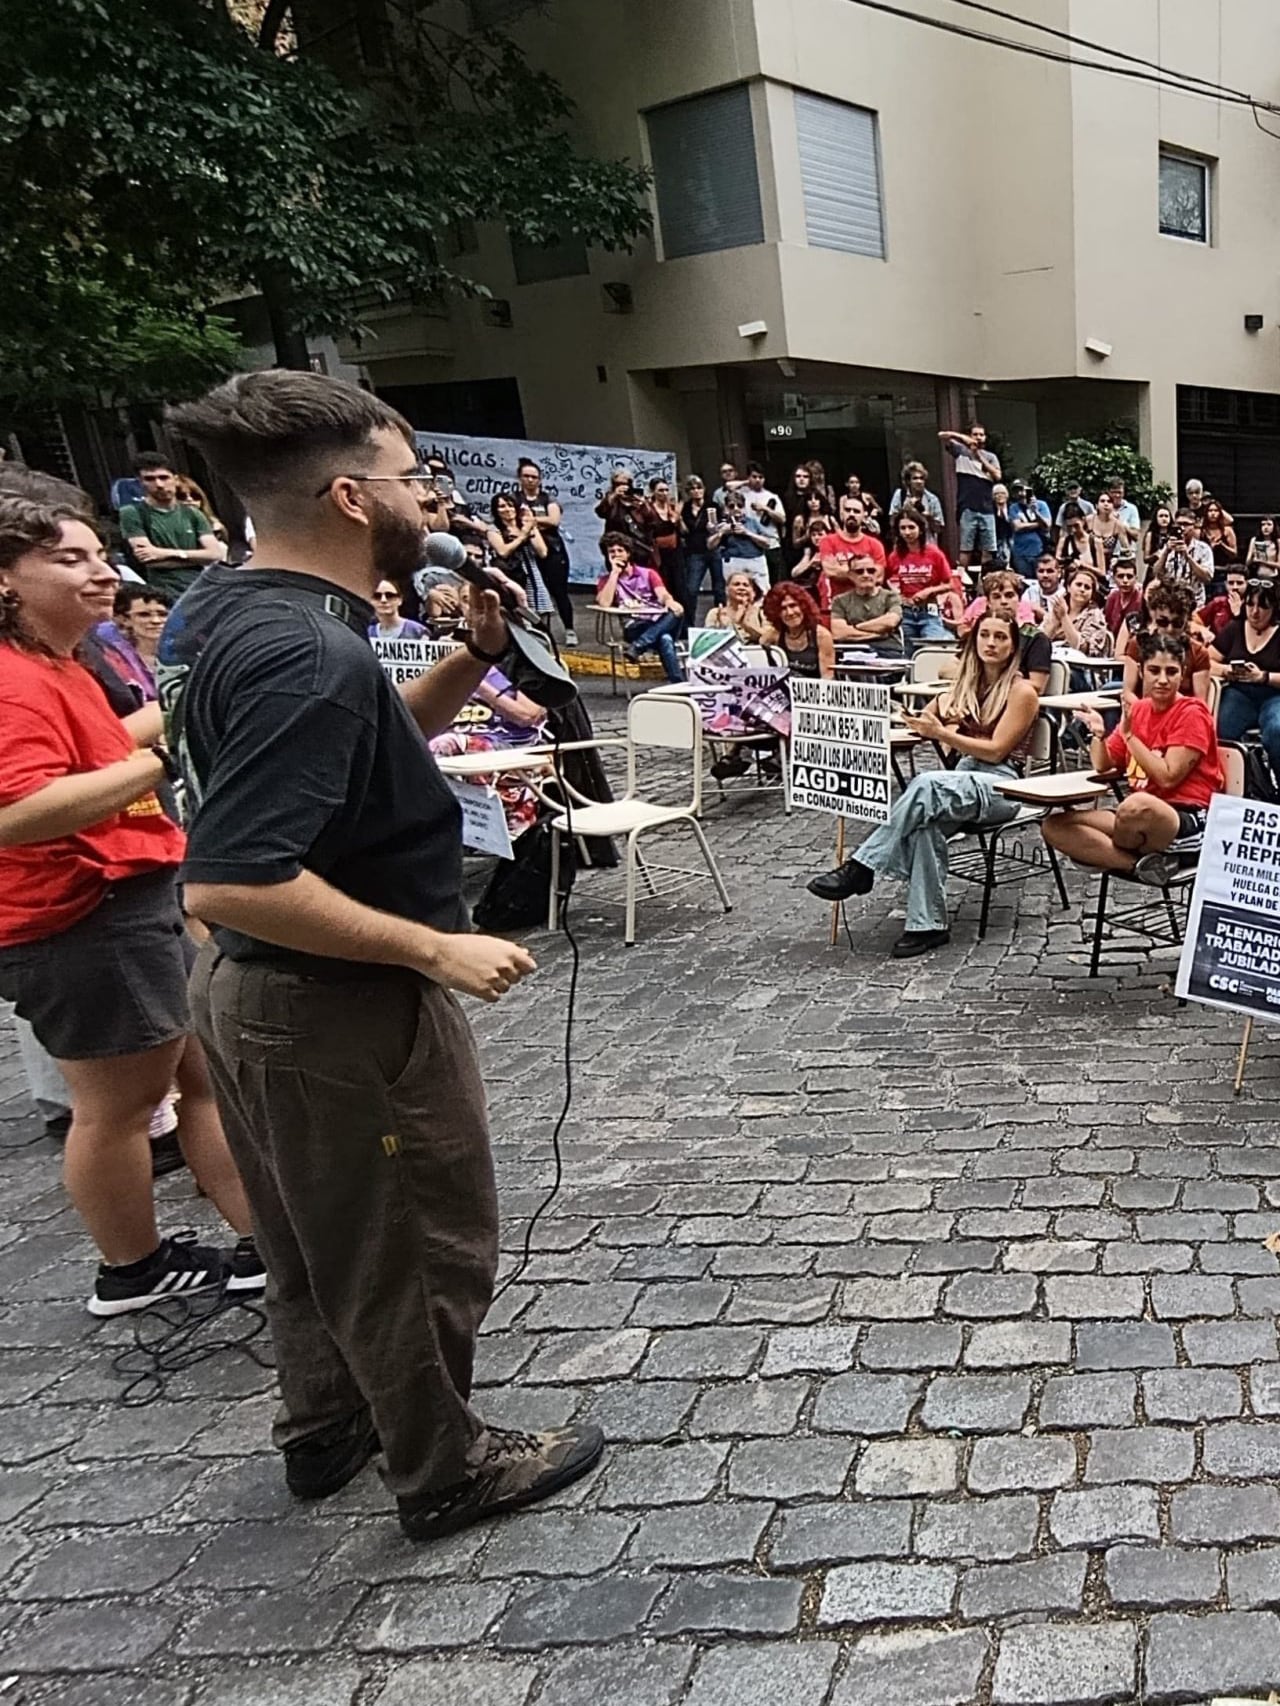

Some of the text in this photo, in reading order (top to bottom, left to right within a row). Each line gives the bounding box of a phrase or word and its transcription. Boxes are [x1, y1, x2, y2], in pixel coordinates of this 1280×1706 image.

[595, 488, 604, 500] s
[375, 641, 423, 661] CANASTA
[792, 682, 820, 705] SALARIO
[857, 687, 888, 712] FAMILIAR
[838, 717, 860, 740] 85%
[793, 740, 822, 765] SALARIO
[792, 793, 804, 803] en
[806, 792, 844, 811] CONADU
[1221, 840, 1233, 856] Y
[1224, 862, 1254, 878] FUERA
[1232, 878, 1270, 895] HUELGA
[1230, 891, 1238, 902] Y
[1238, 893, 1264, 907] PLAN
[1265, 899, 1278, 911] DE
[1209, 974, 1240, 993] CSC
